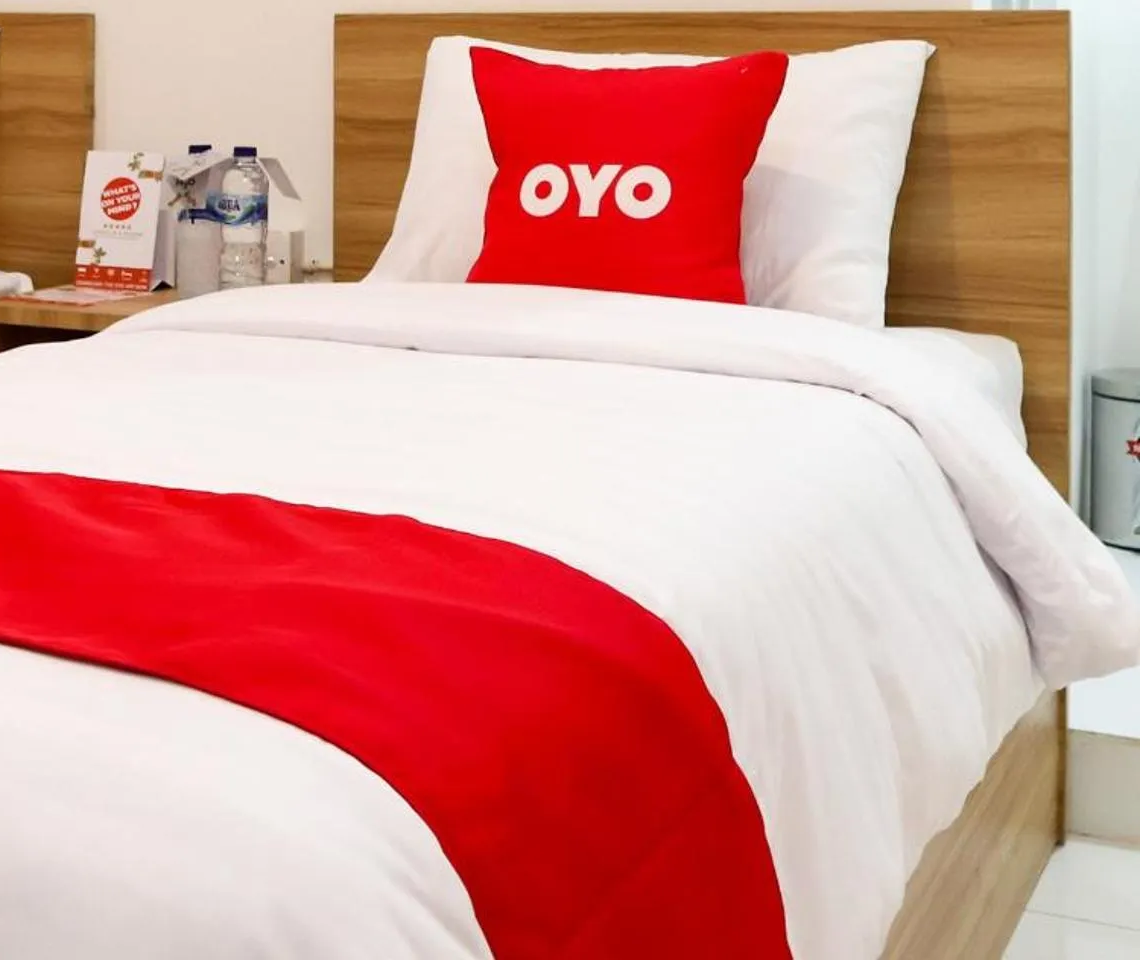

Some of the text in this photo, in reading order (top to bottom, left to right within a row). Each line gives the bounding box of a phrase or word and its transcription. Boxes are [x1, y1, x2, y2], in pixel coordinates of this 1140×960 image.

[100, 192, 141, 208] ON YOUR
[519, 163, 672, 219] OYO
